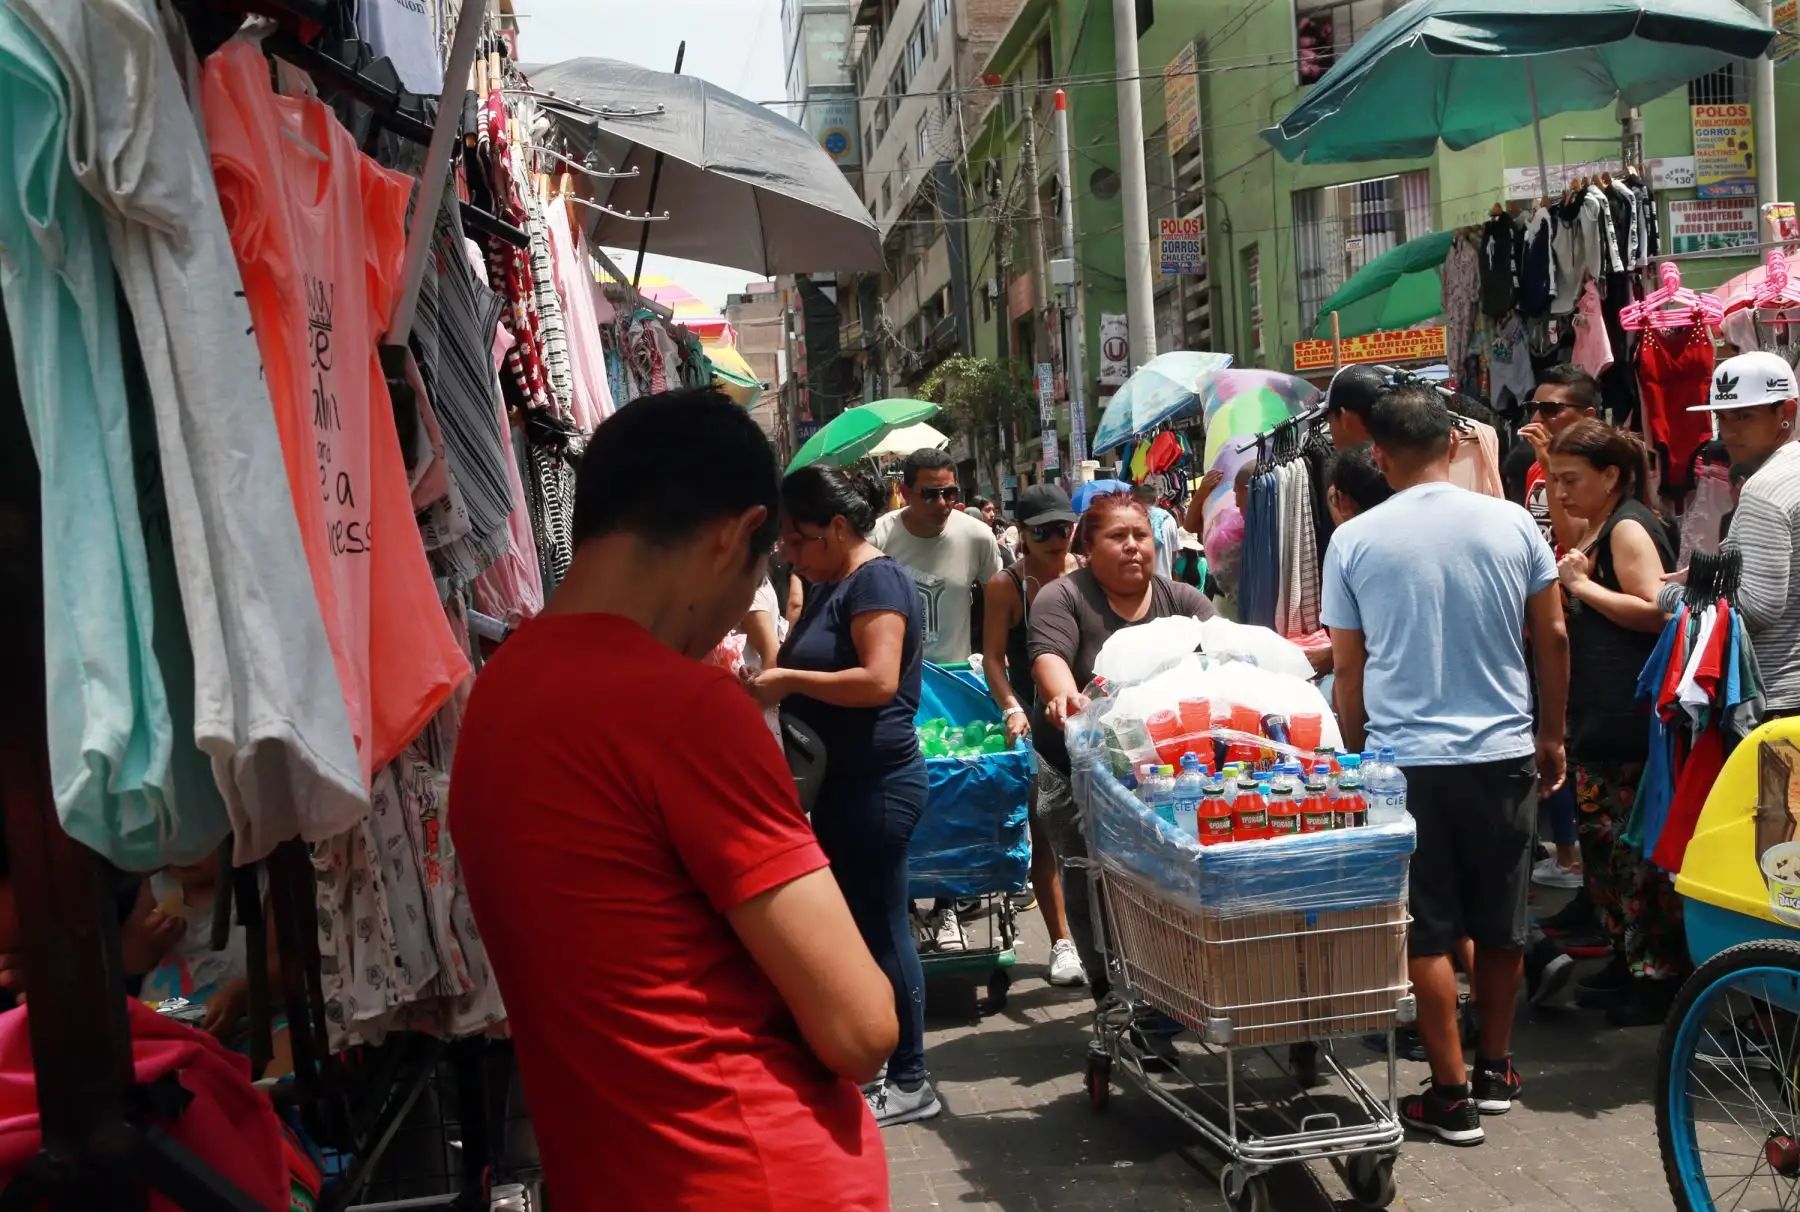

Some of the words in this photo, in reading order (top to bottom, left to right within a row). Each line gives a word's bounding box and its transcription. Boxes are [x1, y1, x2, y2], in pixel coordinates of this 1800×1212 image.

[1696, 106, 1748, 117] POLOS
[1696, 128, 1736, 136] GORROS
[1675, 176, 1691, 184] 130
[1684, 211, 1743, 222] MOSQUITEROS
[1161, 219, 1199, 234] POLOS
[1704, 223, 1715, 232] DE
[1716, 221, 1753, 231] MUEBLES
[1161, 240, 1199, 253] GORROS
[1161, 253, 1199, 262] CHALECOS
[1362, 336, 1443, 350] ENDREDONES
[1108, 341, 1123, 360] U
[1366, 348, 1393, 357] 695
[1714, 392, 1738, 400] adidas
[1307, 817, 1329, 825] SPORADE
